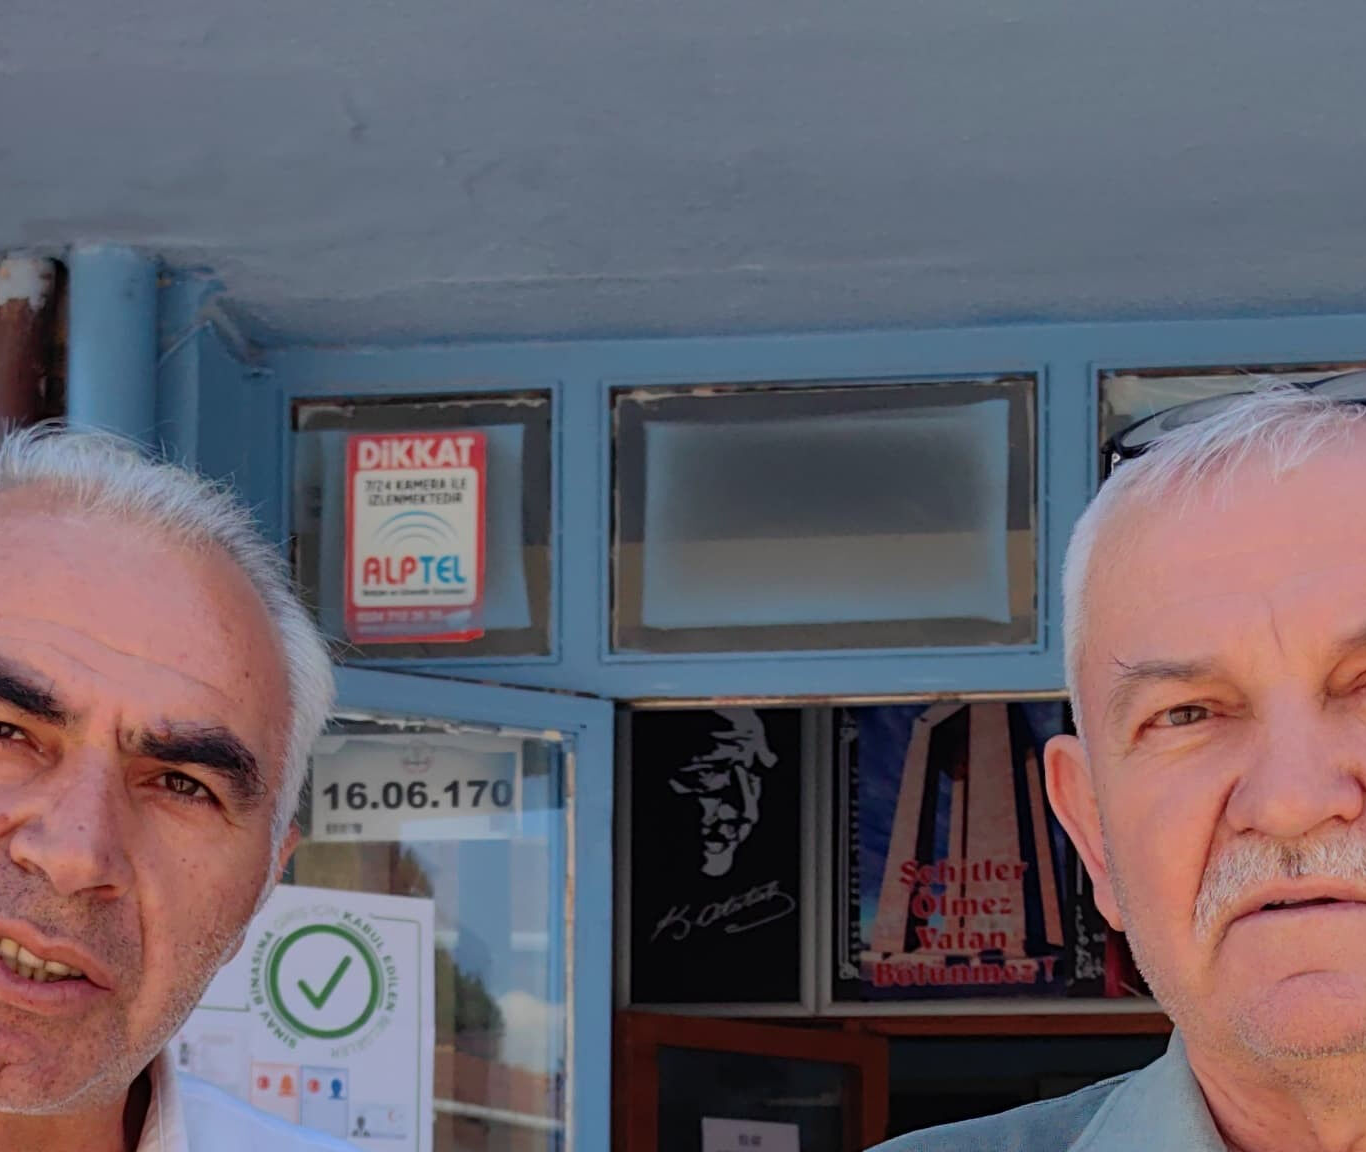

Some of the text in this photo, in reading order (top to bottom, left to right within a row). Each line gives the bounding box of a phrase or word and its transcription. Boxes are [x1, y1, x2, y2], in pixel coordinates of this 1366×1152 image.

[395, 478, 446, 491] KAMERA
[362, 555, 468, 585] ALPTEL
[322, 779, 515, 811] 16.06.170
[342, 911, 385, 949] KABUL
[915, 926, 1008, 951] Vatan
[259, 1011, 297, 1049] SINAV
